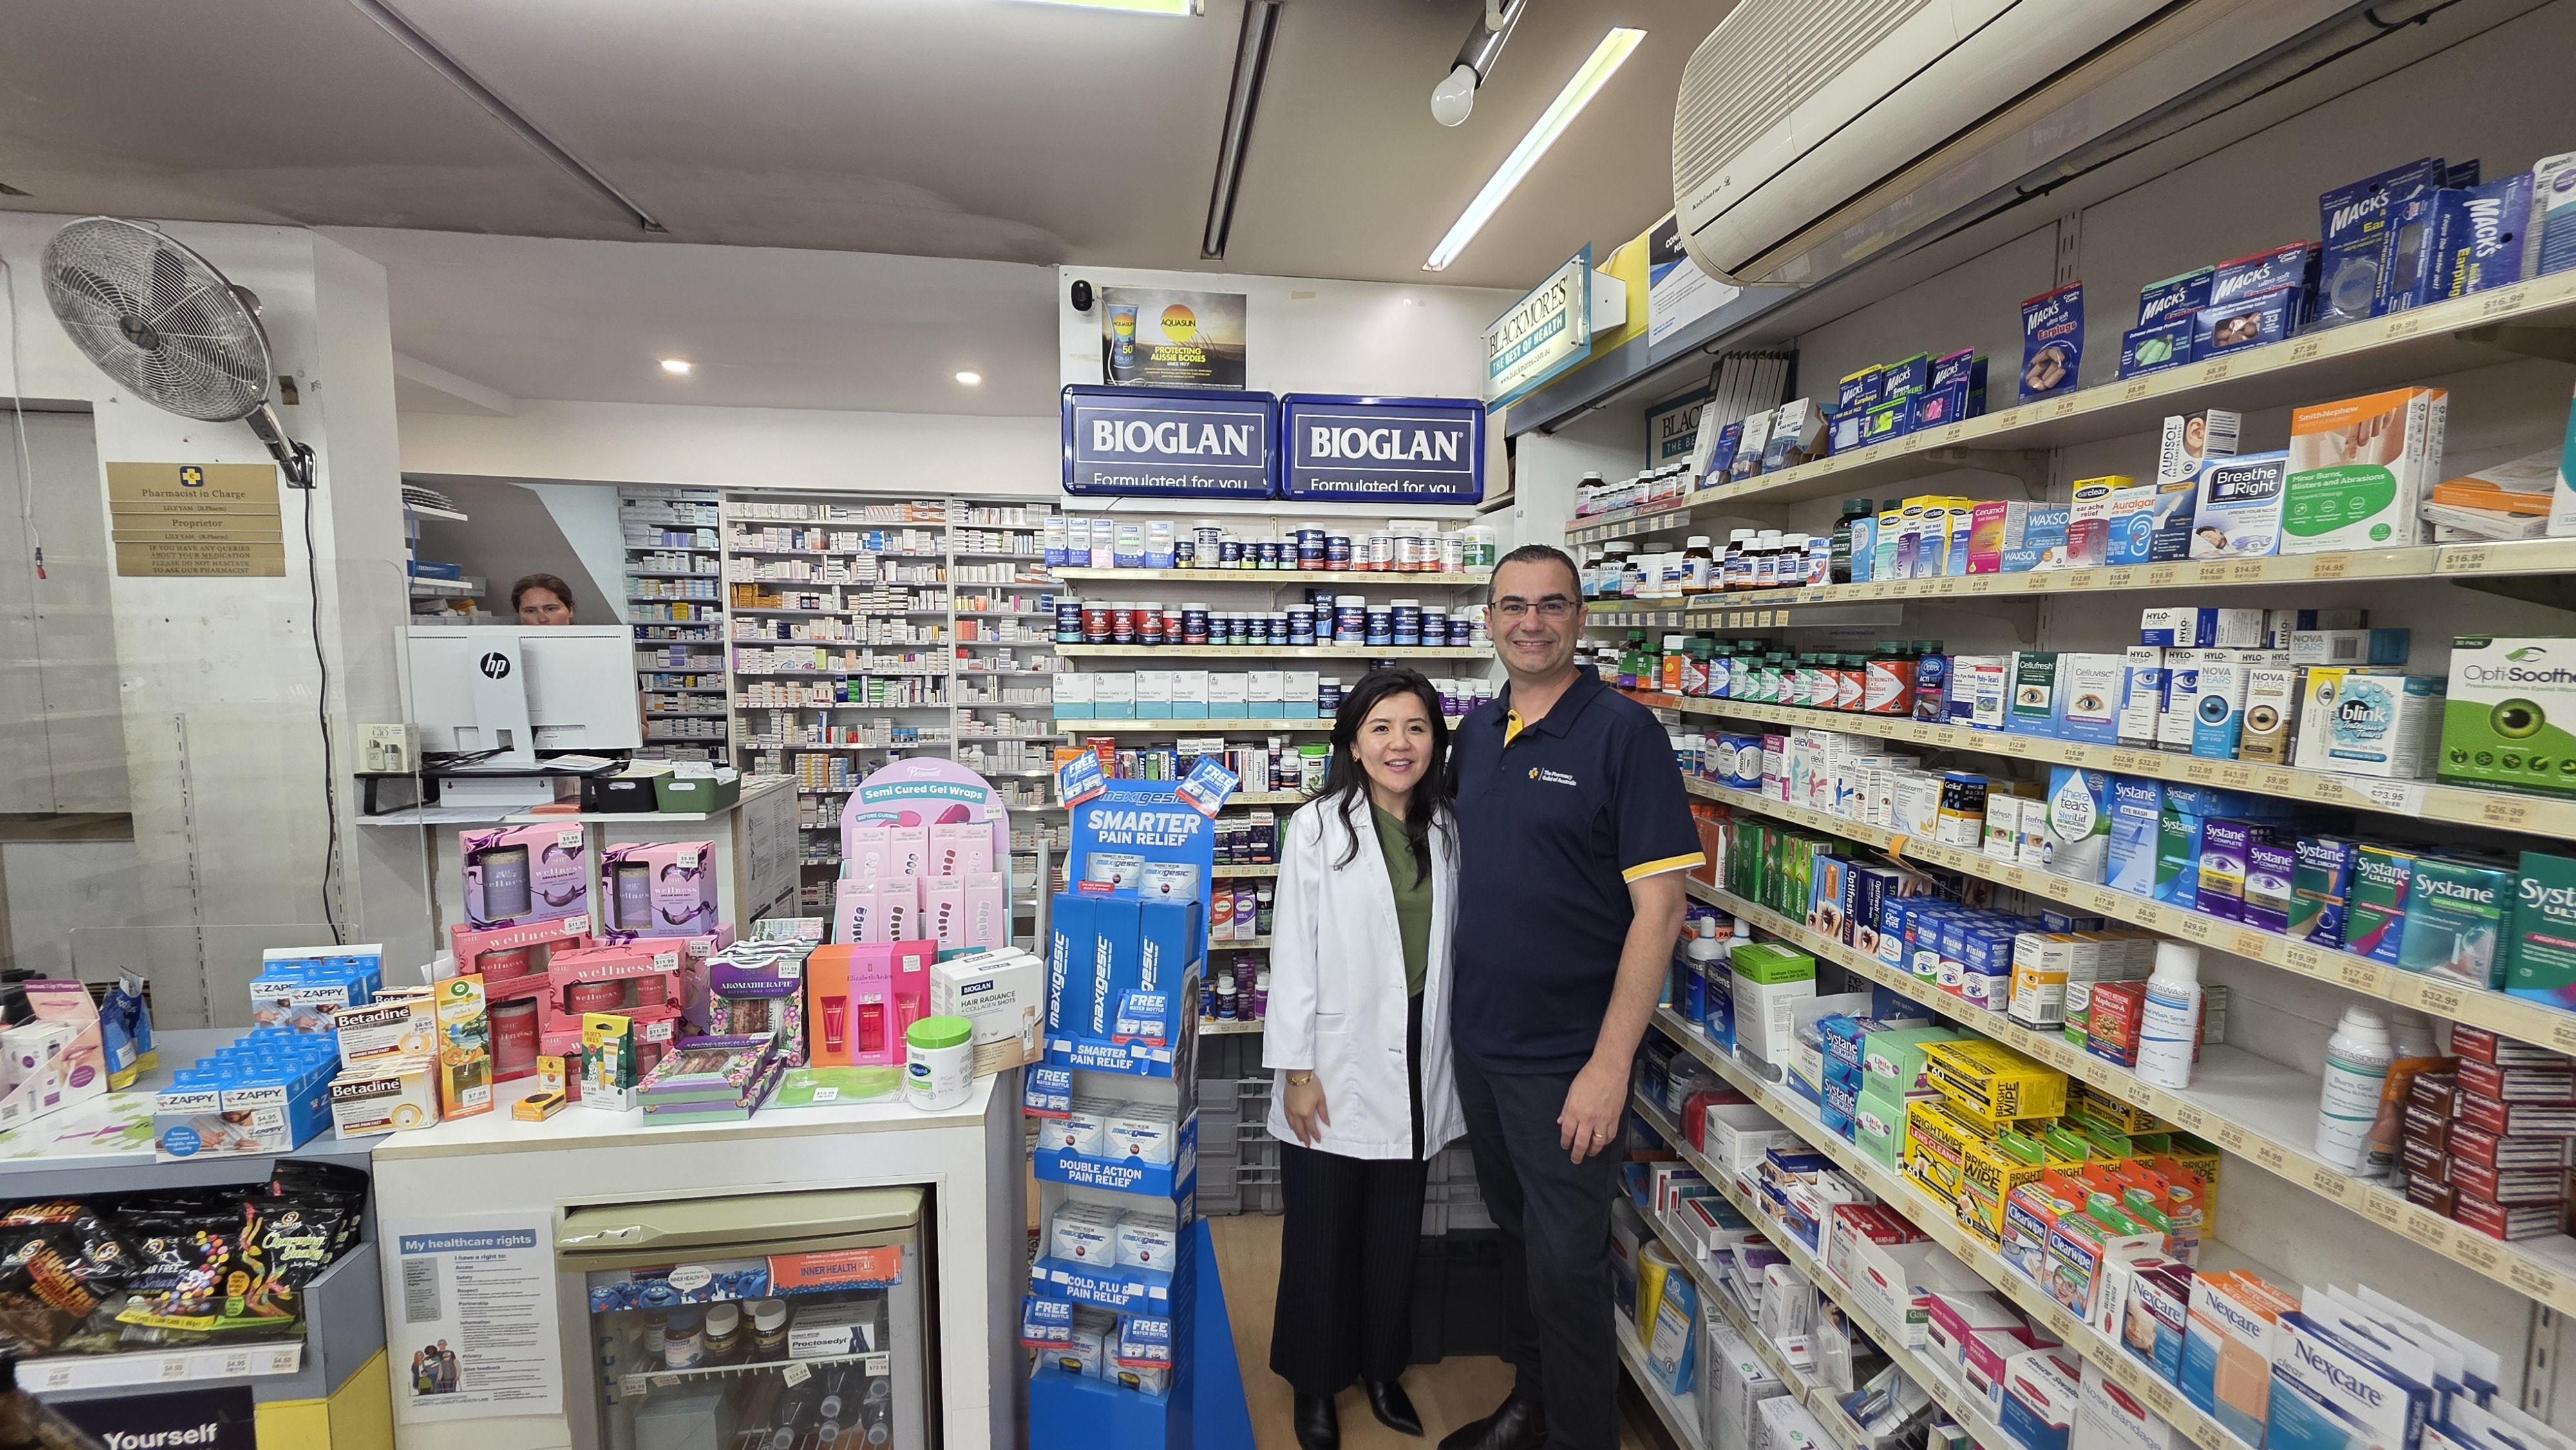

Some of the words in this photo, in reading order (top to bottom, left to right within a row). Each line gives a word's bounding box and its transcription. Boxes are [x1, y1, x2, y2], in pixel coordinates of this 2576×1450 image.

[2330, 189, 2389, 238] MACK'S
[2463, 198, 2501, 258] MACK'S
[2214, 263, 2271, 304] MACK'S
[2141, 287, 2185, 325] MACK'S
[2484, 293, 2524, 309] $16.99
[1160, 319, 1196, 327] AQUASUN
[1490, 278, 1566, 358] BLACKMORES
[2027, 301, 2059, 335] MACK'S
[2389, 319, 2418, 332] $9.99
[2038, 321, 2077, 340] Earplugs
[1155, 346, 1202, 355] PROTECTING
[1492, 357, 1504, 373] THE
[1504, 348, 1521, 365] BEST
[1522, 339, 1533, 353] OF
[1533, 314, 1563, 348] HEALTH
[2293, 343, 2317, 355] $7.99
[1151, 353, 1177, 362] AUSSIE
[1179, 354, 1206, 362] BODIES
[1093, 420, 1249, 457] BIOGLAN
[1310, 426, 1457, 462] BIOGLAN
[2161, 424, 2177, 478] AUDISOL
[1094, 473, 1187, 488] Formulated
[1191, 474, 1217, 488] for
[1220, 478, 1247, 488] you
[2217, 467, 2277, 484] Breathe
[2292, 481, 2322, 490] Blisters
[2323, 478, 2339, 486] and
[2340, 473, 2385, 484] Abrasions
[2293, 474, 2315, 482] Minor
[2316, 471, 2343, 479] Burns,
[142, 489, 196, 498] Pharmacist
[200, 489, 209, 498] in
[212, 490, 245, 498] Charge
[2235, 481, 2276, 495] Right
[1975, 505, 2004, 516] Cerumol
[172, 519, 223, 529] Proprietor
[2004, 551, 2037, 561] WAXSOL
[2447, 554, 2486, 563] $16.95
[2314, 564, 2345, 572] $14.95
[2293, 634, 2324, 645] NOVA
[2293, 643, 2324, 652] TEARS
[484, 652, 507, 679] hp
[2020, 661, 2054, 670] Cellufresh
[2076, 668, 2110, 677] Celluvisc
[2202, 666, 2231, 677] NOVA
[2201, 675, 2231, 684] TEARS
[2252, 672, 2284, 682] NOVA
[2252, 681, 2284, 690] TEARS
[2342, 704, 2387, 722] blink
[1810, 755, 1824, 765] elevit
[2112, 755, 2135, 764] $32.95
[2223, 769, 2249, 780] $43.95
[2266, 776, 2288, 786] $9.95
[866, 786, 893, 799] Semi
[895, 785, 927, 794] Cured
[929, 786, 947, 794] Gel
[949, 787, 983, 799] Wraps
[2061, 787, 2090, 802] thera
[2115, 782, 2155, 802] Systane
[2318, 783, 2342, 793] $9.50
[2060, 797, 2089, 813] tears
[2484, 805, 2524, 816] $26.99
[1087, 810, 1201, 834] SMARTER
[2163, 816, 2197, 833] Systane
[1099, 831, 1132, 844] PAIN
[1136, 834, 1188, 847] RELIEF
[2206, 824, 2245, 841] Systane
[2213, 836, 2242, 847] COMPLETE
[2251, 847, 2292, 866] Systane
[2296, 841, 2344, 862] Systane
[1096, 860, 1139, 868] maxigesic
[2357, 857, 2410, 880] Systane
[2369, 874, 2404, 887] ULTRA
[2415, 874, 2494, 903] Systane
[489, 929, 567, 947] wellness
[2287, 950, 2317, 964] $19.99
[578, 964, 655, 978] wellness
[1049, 930, 1065, 1028] maxigesic
[2342, 967, 2374, 982] $17.50
[721, 981, 793, 990] AROMATHERAPIE
[963, 983, 992, 993] BIOGLAN
[1094, 935, 1108, 1033] maxigesic
[303, 988, 343, 997] ZAPPY
[961, 997, 978, 1008] HAIR
[980, 991, 1016, 1003] RADIANCE
[2421, 990, 2458, 1006] $32.95
[1130, 994, 1166, 1008] FREE
[2096, 995, 2125, 1012] Naphcon-A
[338, 1006, 410, 1027] Betadine
[1826, 1028, 1859, 1055] Systane
[1077, 1044, 1126, 1059] SMARTER
[1070, 1054, 1094, 1066] PAIN
[1097, 1057, 1133, 1069] RELIEF
[237, 1089, 281, 1100] ZAPPY
[332, 1079, 399, 1097] Betadine
[1824, 1078, 1855, 1105] Systane
[169, 1095, 214, 1105] ZAPPY
[1996, 1082, 2004, 1118] BRIGHT
[2005, 1082, 2017, 1116] WIPE
[258, 1115, 277, 1123] $4.95
[1911, 1128, 1927, 1144] LENS
[1927, 1138, 1962, 1165] CLEANER
[1059, 1159, 1100, 1173] DOUBLE
[1103, 1166, 1142, 1180] ACTION
[1965, 1151, 2003, 1178] BRIGHT
[1069, 1171, 1093, 1183] PAIN
[1095, 1175, 1132, 1188] RELIEF
[1964, 1160, 2000, 1189] WIPE
[2313, 1172, 2345, 1192] $12.99
[2009, 1205, 2045, 1237] Clearwipe
[405, 1240, 426, 1252] My
[428, 1237, 493, 1248] healthcare
[497, 1236, 531, 1247] rights
[2051, 1234, 2091, 1269] Clearwipe
[800, 1266, 825, 1276] INNER
[826, 1263, 857, 1274] HEALTH
[858, 1261, 875, 1272] PLUS
[2063, 1266, 2086, 1286] Antifog
[1068, 1276, 1095, 1290] COLD,
[1099, 1281, 1119, 1292] FLU
[1066, 1286, 1093, 1299] PAIN
[1095, 1292, 1129, 1305] RELIEF
[2134, 1279, 2181, 1321] Nexcare
[2205, 1291, 2261, 1337] Nexcare
[1133, 1319, 1168, 1332] FREE
[792, 1337, 847, 1348] Proctosedyl
[2294, 1337, 2383, 1406] Nexcare
[2083, 1380, 2108, 1408] Nose
[2111, 1406, 2161, 1450] Bandage
[103, 1423, 218, 1450] Yourself
